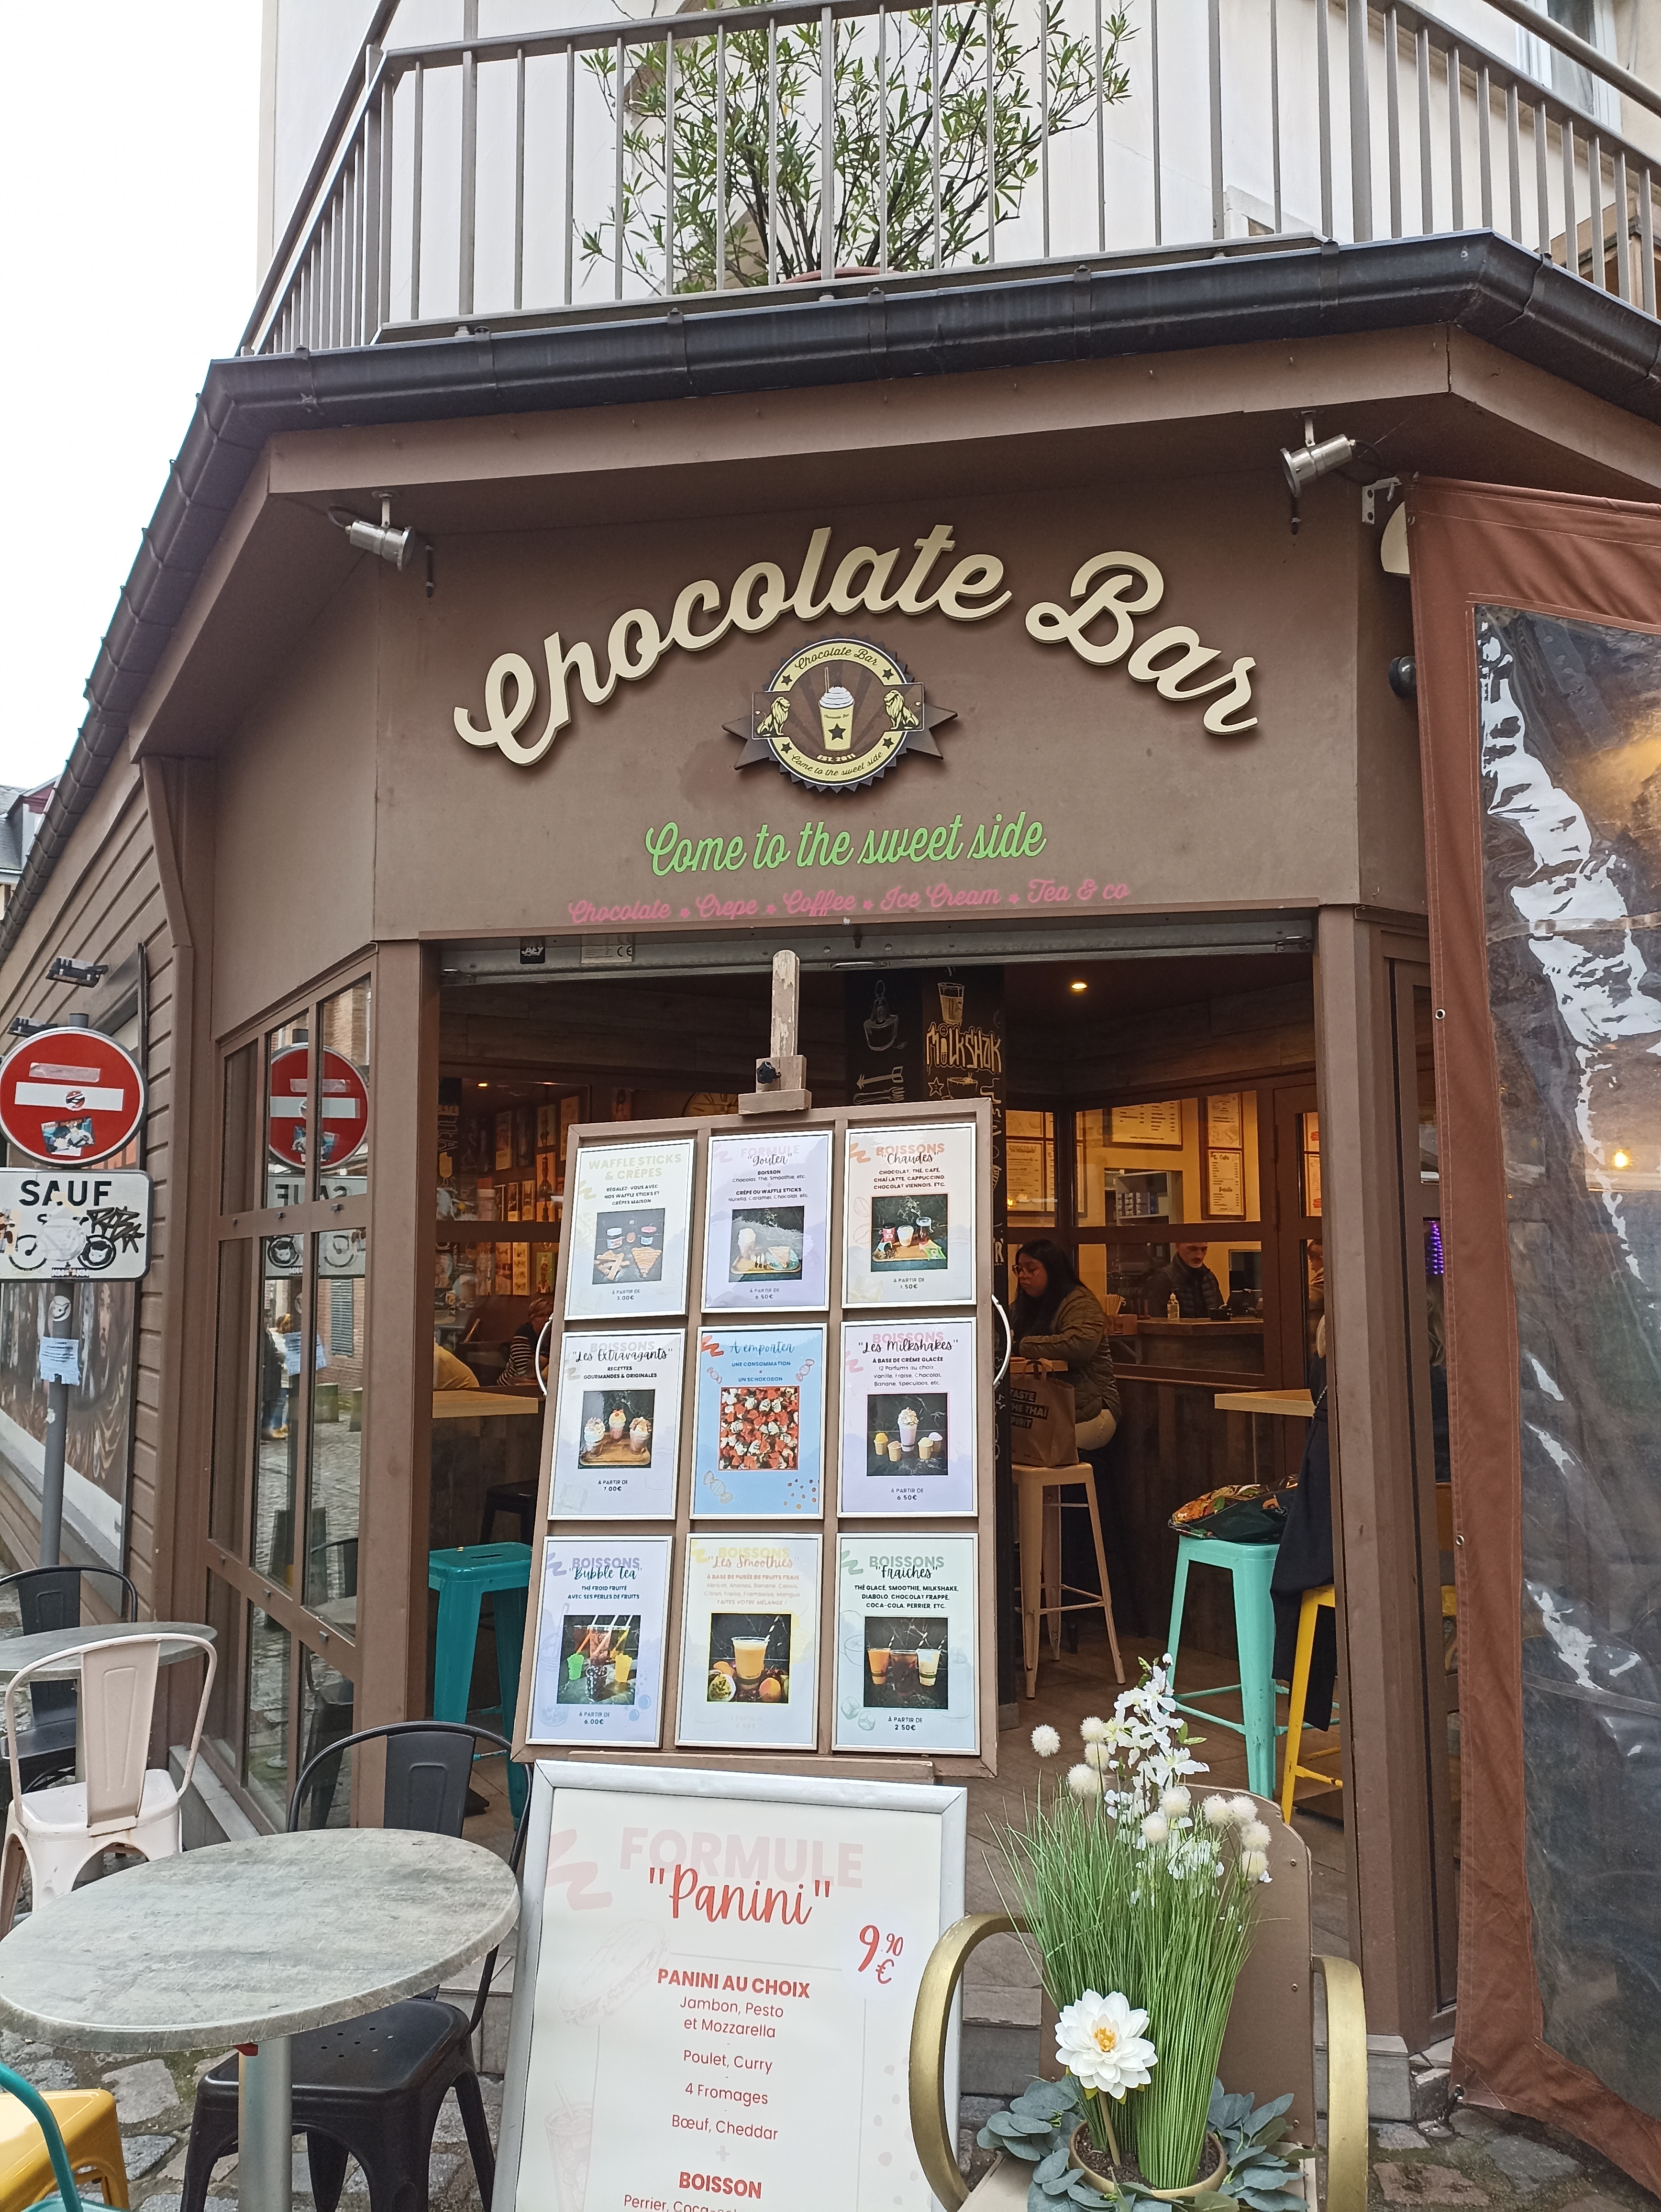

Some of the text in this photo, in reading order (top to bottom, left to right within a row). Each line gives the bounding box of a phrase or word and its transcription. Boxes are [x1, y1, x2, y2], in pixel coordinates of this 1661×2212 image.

[454, 524, 1258, 766] Chocolate Bar
[795, 647, 878, 670] Chocolate Bar
[791, 754, 813, 772] Come
[814, 766, 823, 775] to
[841, 763, 865, 775] sweet
[867, 752, 883, 768] side
[836, 753, 856, 762] 2011
[644, 811, 1047, 876] Come to the sweet side
[568, 879, 1130, 924] Chocolate Crepe Coffee Ice Cream Tea & co
[741, 1145, 800, 1157] FORMULE
[876, 1143, 945, 1156] BOISSONS
[588, 1153, 682, 1170] WAFFLE STICKS
[605, 1166, 662, 1181] & CRÊPES
[19, 1180, 111, 1206] SAUF
[590, 1341, 655, 1353] BOISSONS
[873, 1331, 944, 1344] BOISSONS
[743, 1340, 795, 1356] emporter
[1025, 1405, 1047, 1417] THAI
[1010, 1416, 1031, 1427] PIRIT
[572, 1557, 640, 1569] BOISSONS
[718, 1547, 789, 1559] BOISSONS
[869, 1556, 944, 1568] BOISSONS
[620, 1826, 863, 1888] FORMULE
[648, 1864, 830, 1925] "Panini"
[657, 1969, 810, 1999] PANINI AU CHOIX
[680, 1996, 784, 2017] Jambon, Pesto
[684, 2018, 775, 2038] et Mozzarella
[684, 2050, 773, 2075] Poulet, Curry
[685, 2082, 768, 2106] 4 Fromages
[672, 2114, 778, 2140] Bœuf, Cheddar
[679, 2171, 762, 2199] BOISSON
